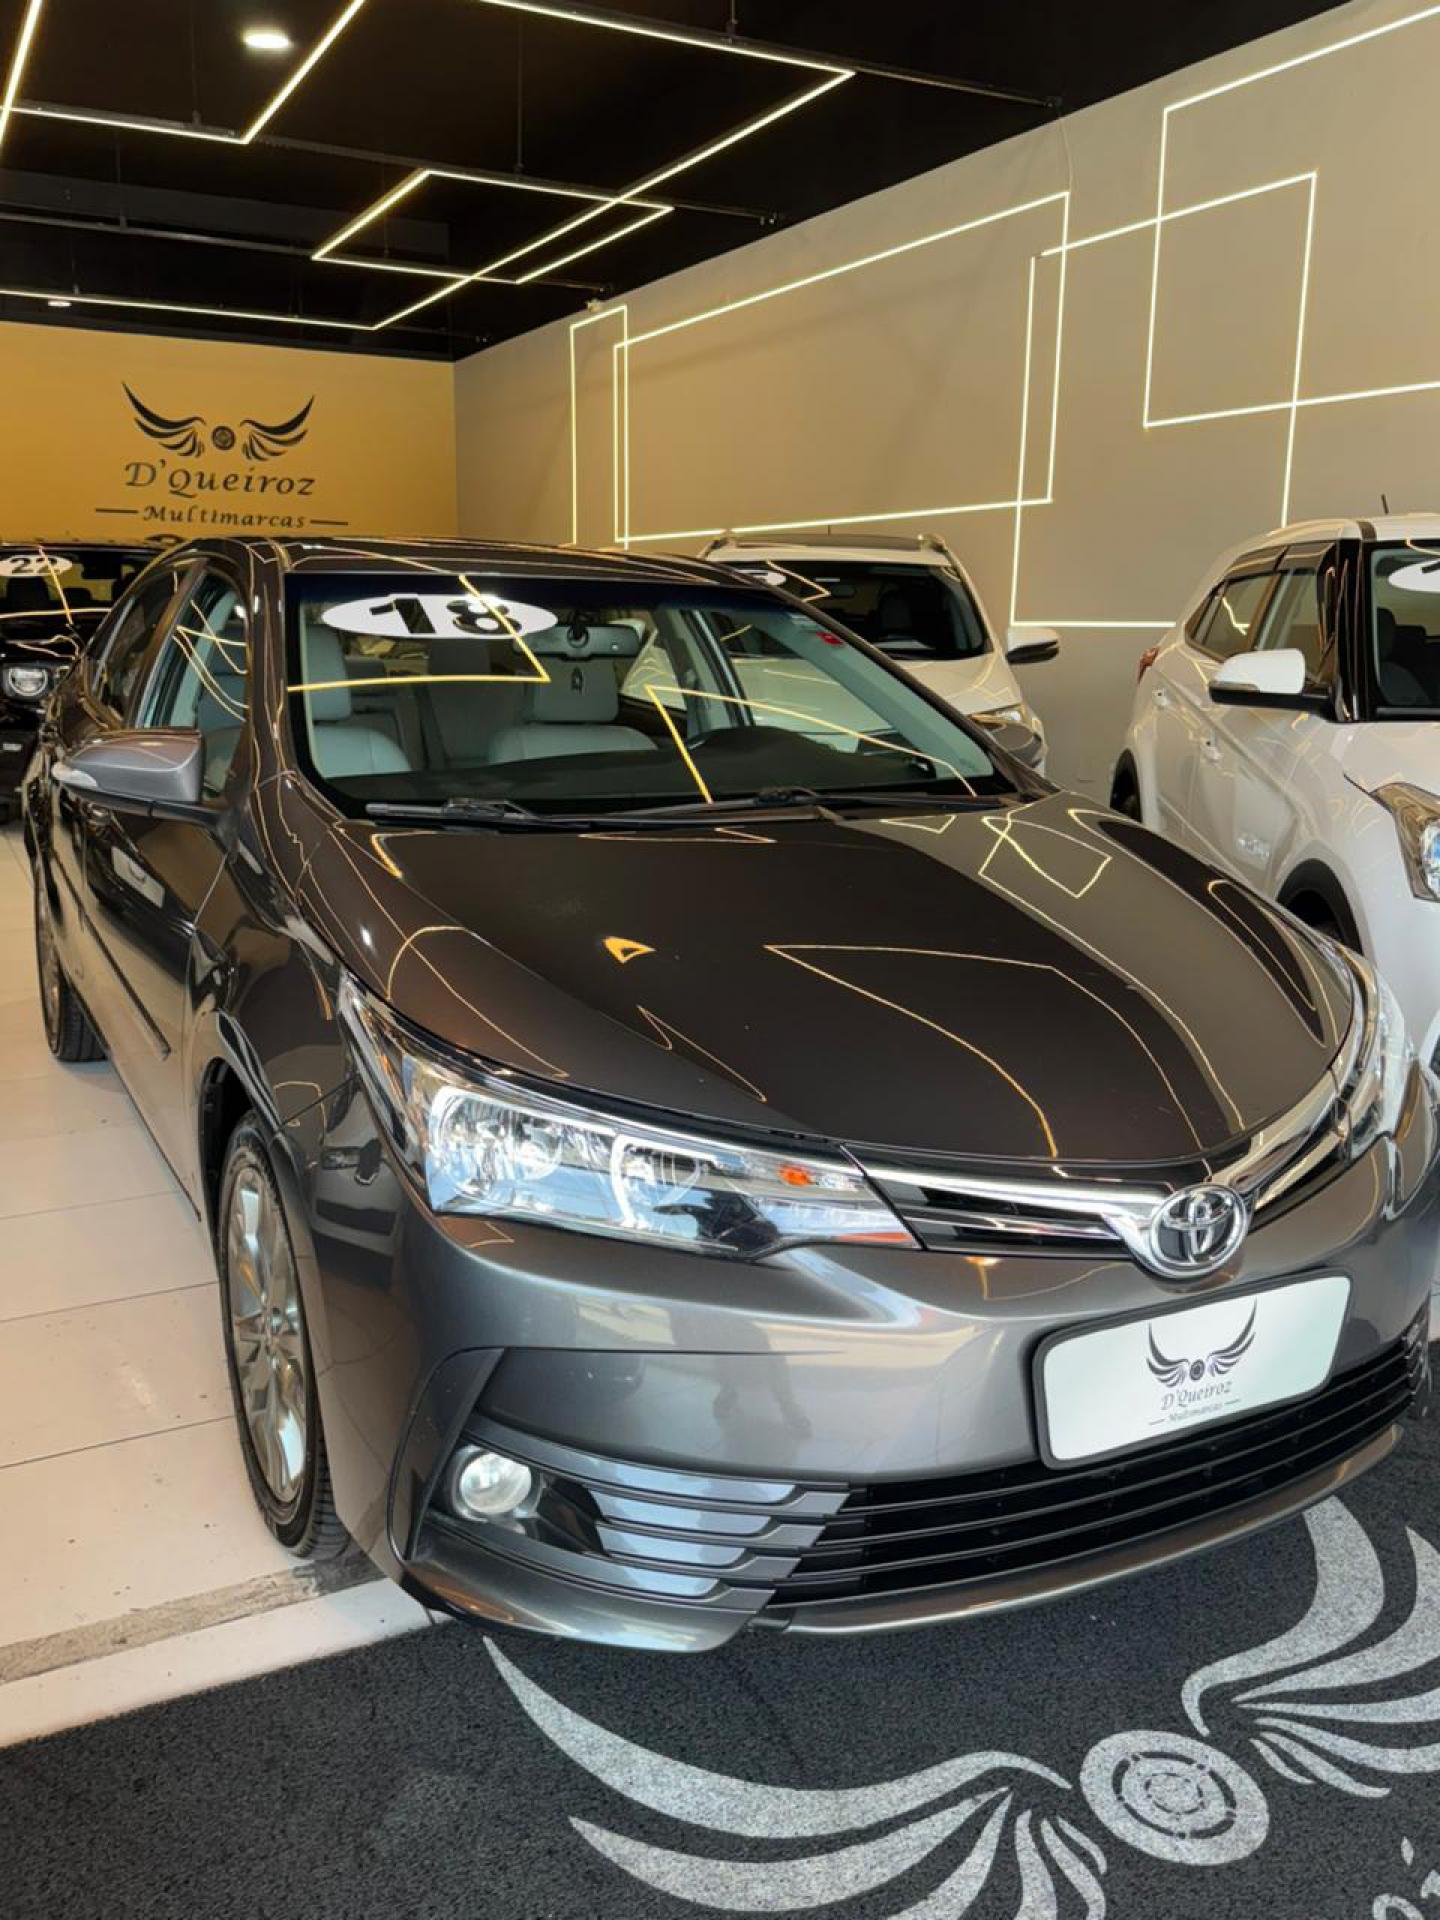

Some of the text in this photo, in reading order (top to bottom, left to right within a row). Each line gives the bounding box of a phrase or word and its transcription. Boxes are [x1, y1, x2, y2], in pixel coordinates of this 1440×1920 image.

[125, 459, 315, 498] D'Queiroz
[143, 504, 306, 528] Multimarcas
[369, 598, 522, 635] 18
